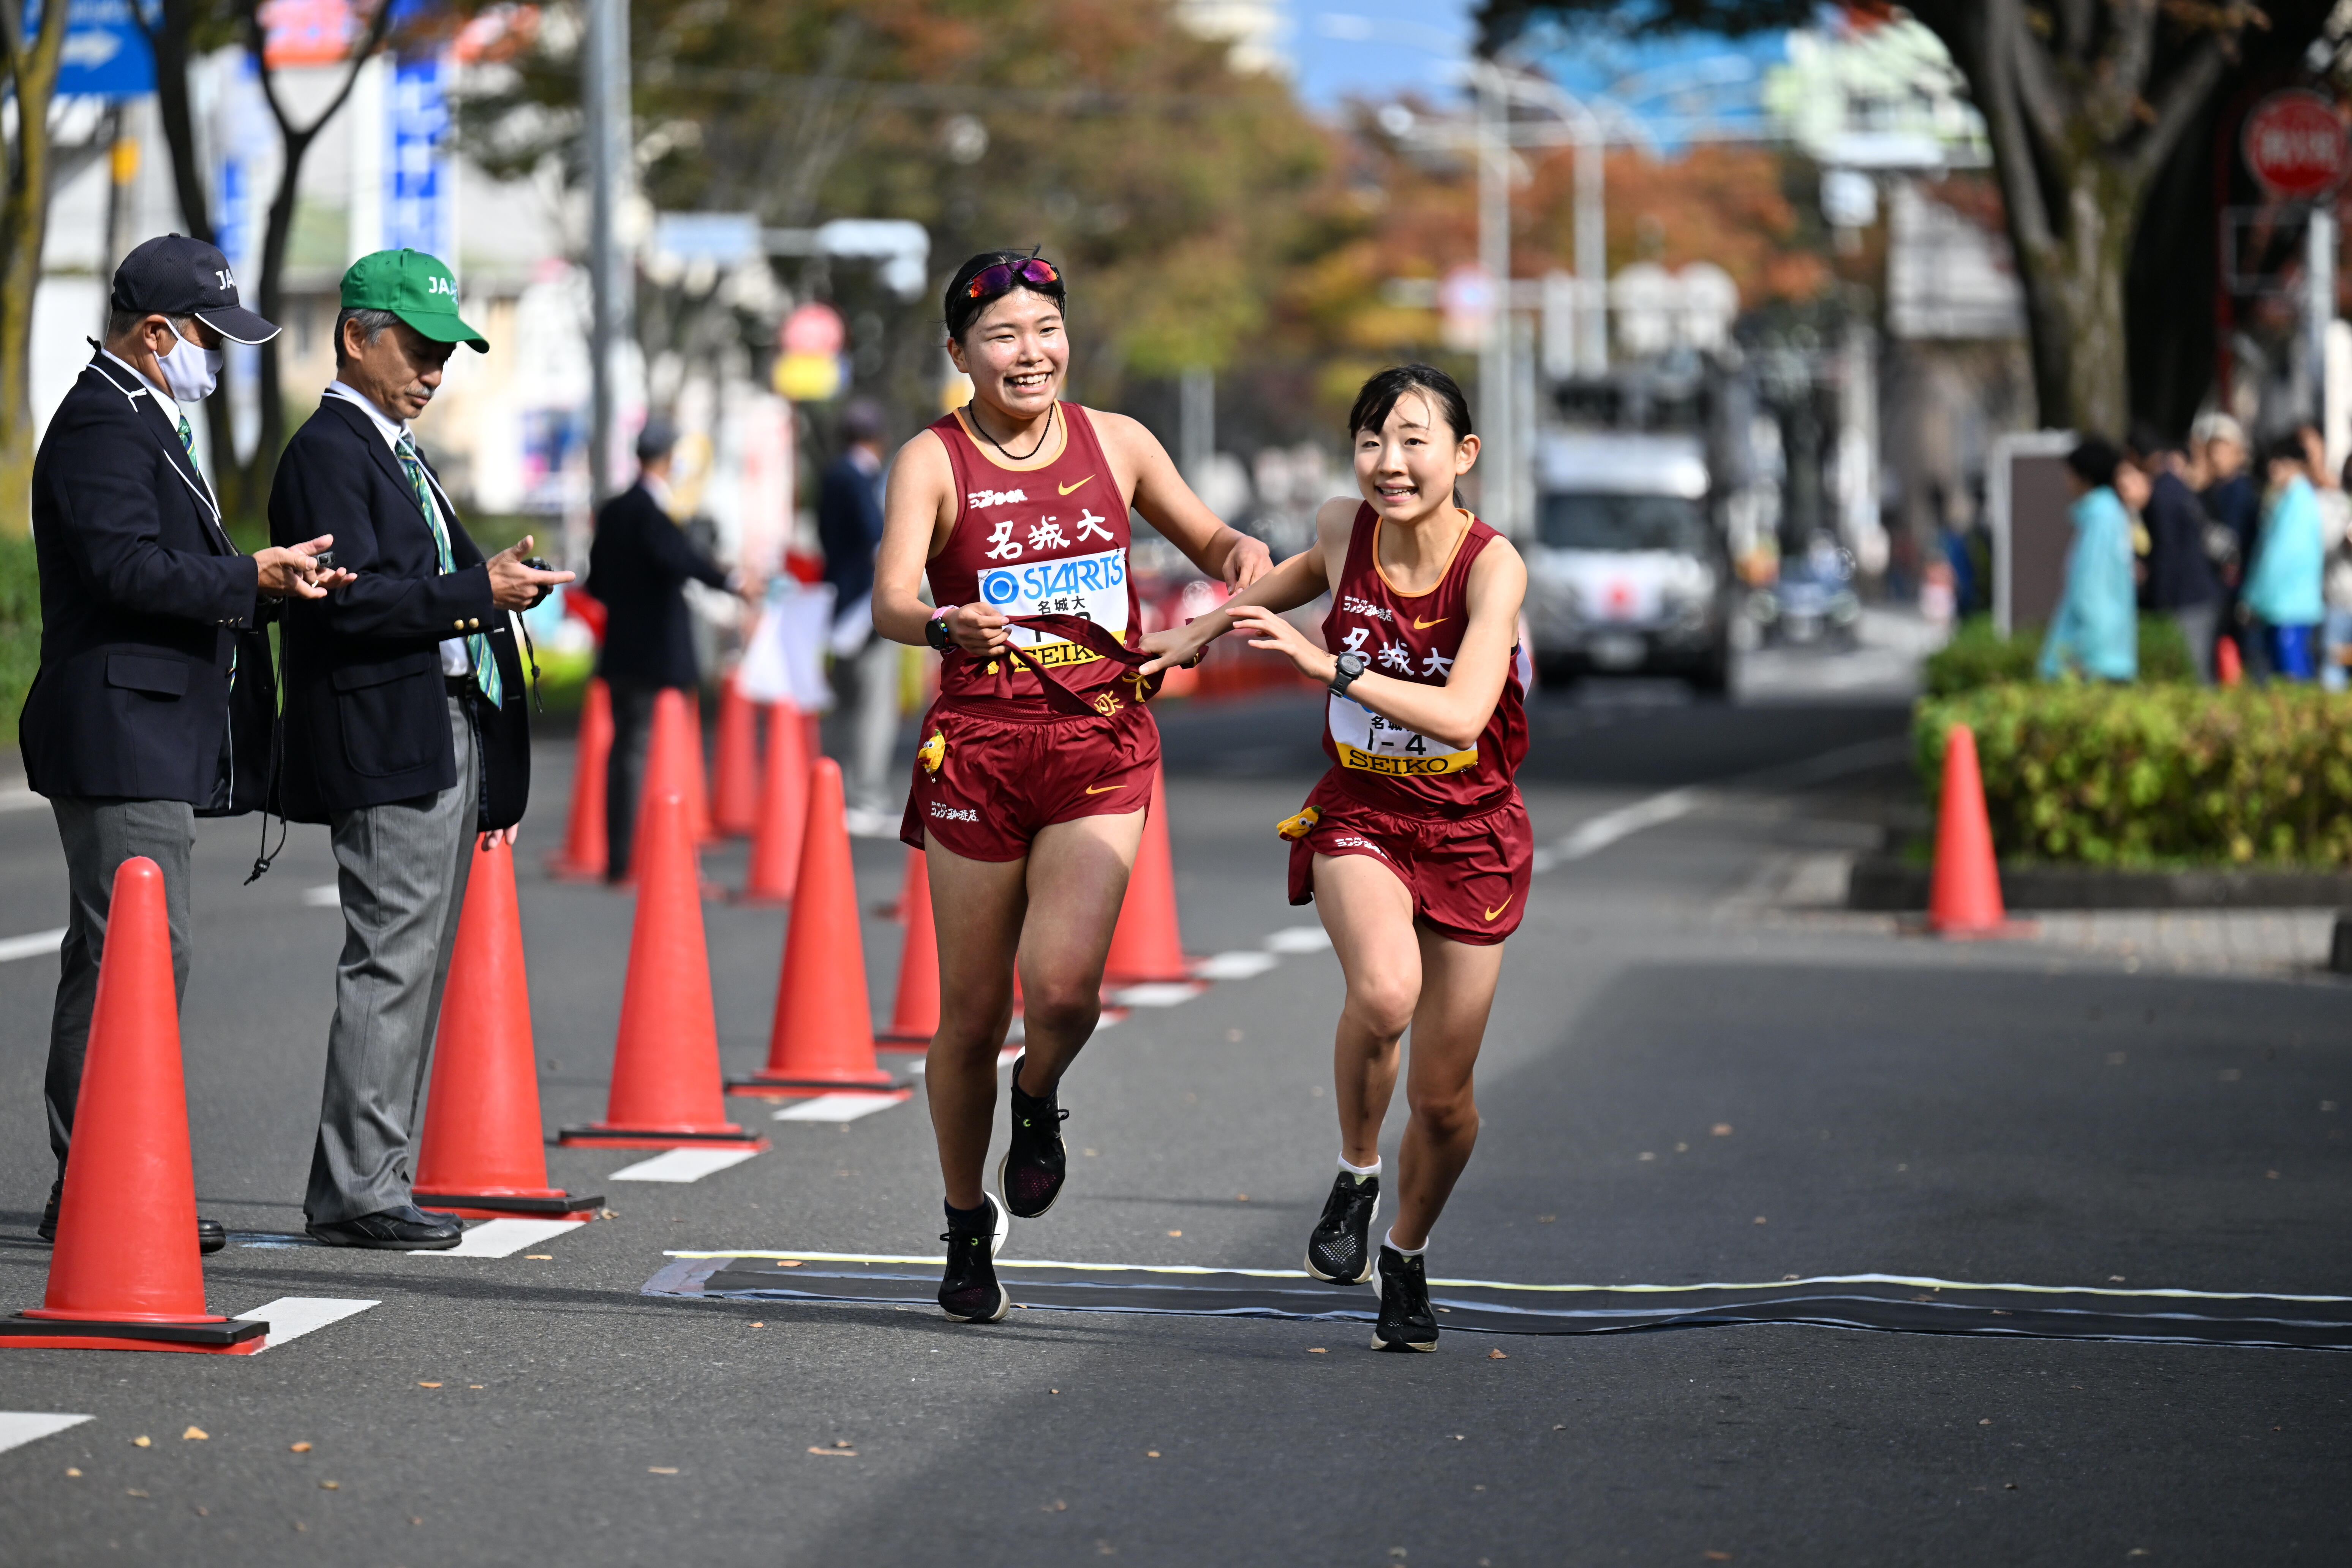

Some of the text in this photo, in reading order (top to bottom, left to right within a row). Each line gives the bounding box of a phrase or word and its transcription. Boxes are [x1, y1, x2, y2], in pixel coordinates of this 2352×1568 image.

[985, 509, 1114, 560] 名城大
[1024, 554, 1124, 599] STARTS
[1038, 595, 1086, 615] 名城大
[1018, 643, 1102, 669] SEIK
[1339, 627, 1454, 678] 名城大
[1367, 727, 1427, 755] 1-4
[1349, 749, 1448, 774] SEIKO
